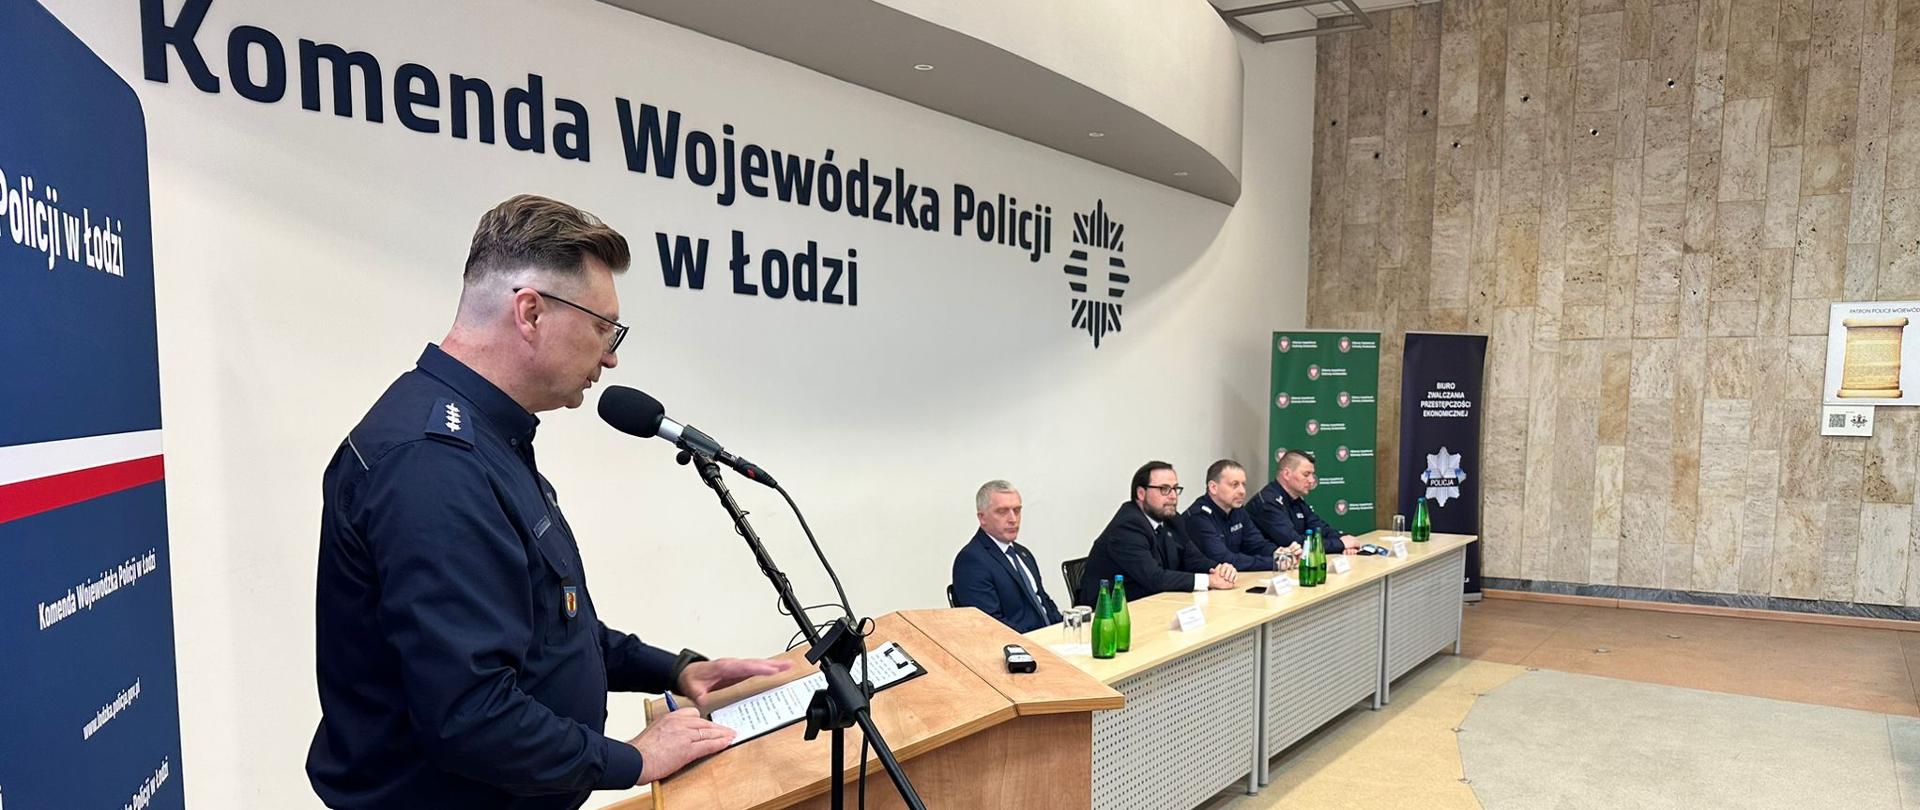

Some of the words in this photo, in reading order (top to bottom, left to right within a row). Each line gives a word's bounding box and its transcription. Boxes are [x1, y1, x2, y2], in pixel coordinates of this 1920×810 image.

[140, 0, 591, 163] Komenda
[615, 96, 940, 232] Wojewódzka
[953, 183, 1052, 263] Policji
[63, 211, 80, 263] w
[83, 207, 124, 278] Łodzi
[655, 231, 710, 291] w
[729, 230, 859, 307] Łodzi
[1420, 400, 1471, 409] PRZESTĘPCZOŚCI
[1427, 391, 1465, 399] ZWALCZANIA
[1436, 382, 1456, 390] BIURO
[1423, 409, 1469, 417] EKONOMICZNEJ
[38, 589, 77, 631] Komenda
[76, 568, 119, 611] Wojewódzka
[118, 556, 136, 587] Policji
[136, 560, 142, 578] w
[141, 547, 156, 576] Łodzi
